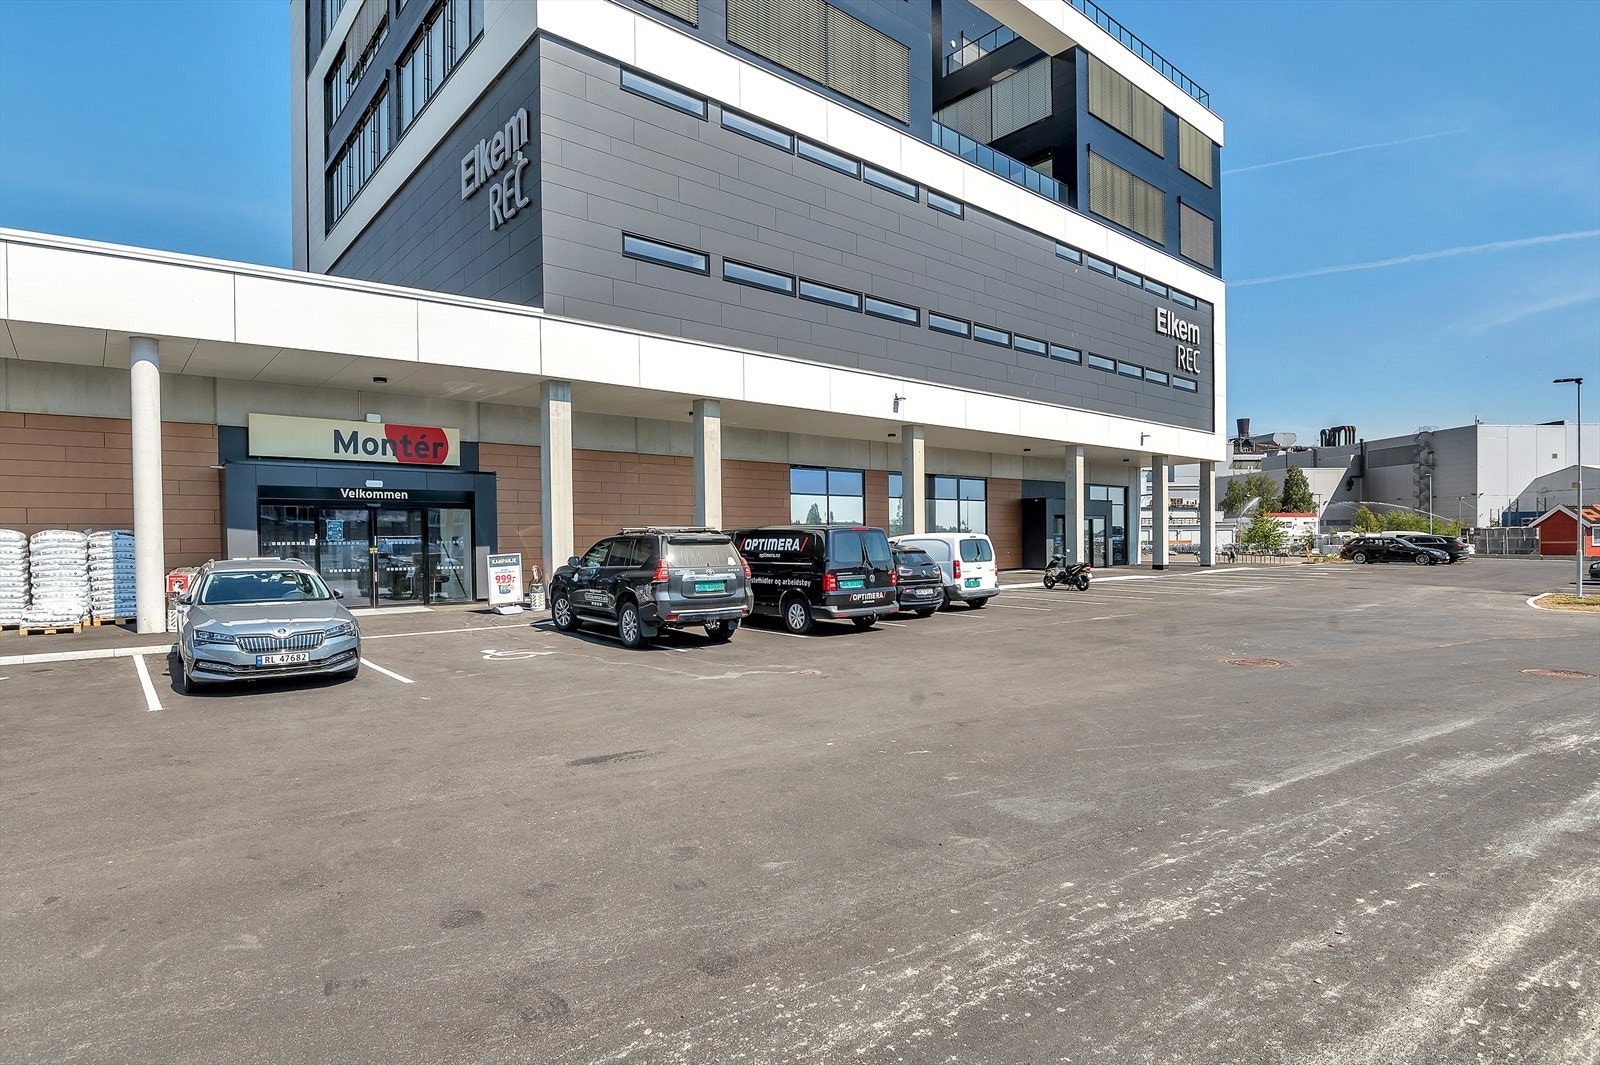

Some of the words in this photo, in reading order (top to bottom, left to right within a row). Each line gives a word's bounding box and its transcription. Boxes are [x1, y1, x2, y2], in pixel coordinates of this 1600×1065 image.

[461, 107, 529, 200] Elkem
[489, 157, 530, 231] REC
[1156, 306, 1200, 345] Elkem
[1177, 344, 1201, 374] REC
[333, 429, 444, 460] Montér
[340, 488, 409, 500] Velkommen
[264, 656, 276, 664] RL
[279, 653, 307, 662] 47682
